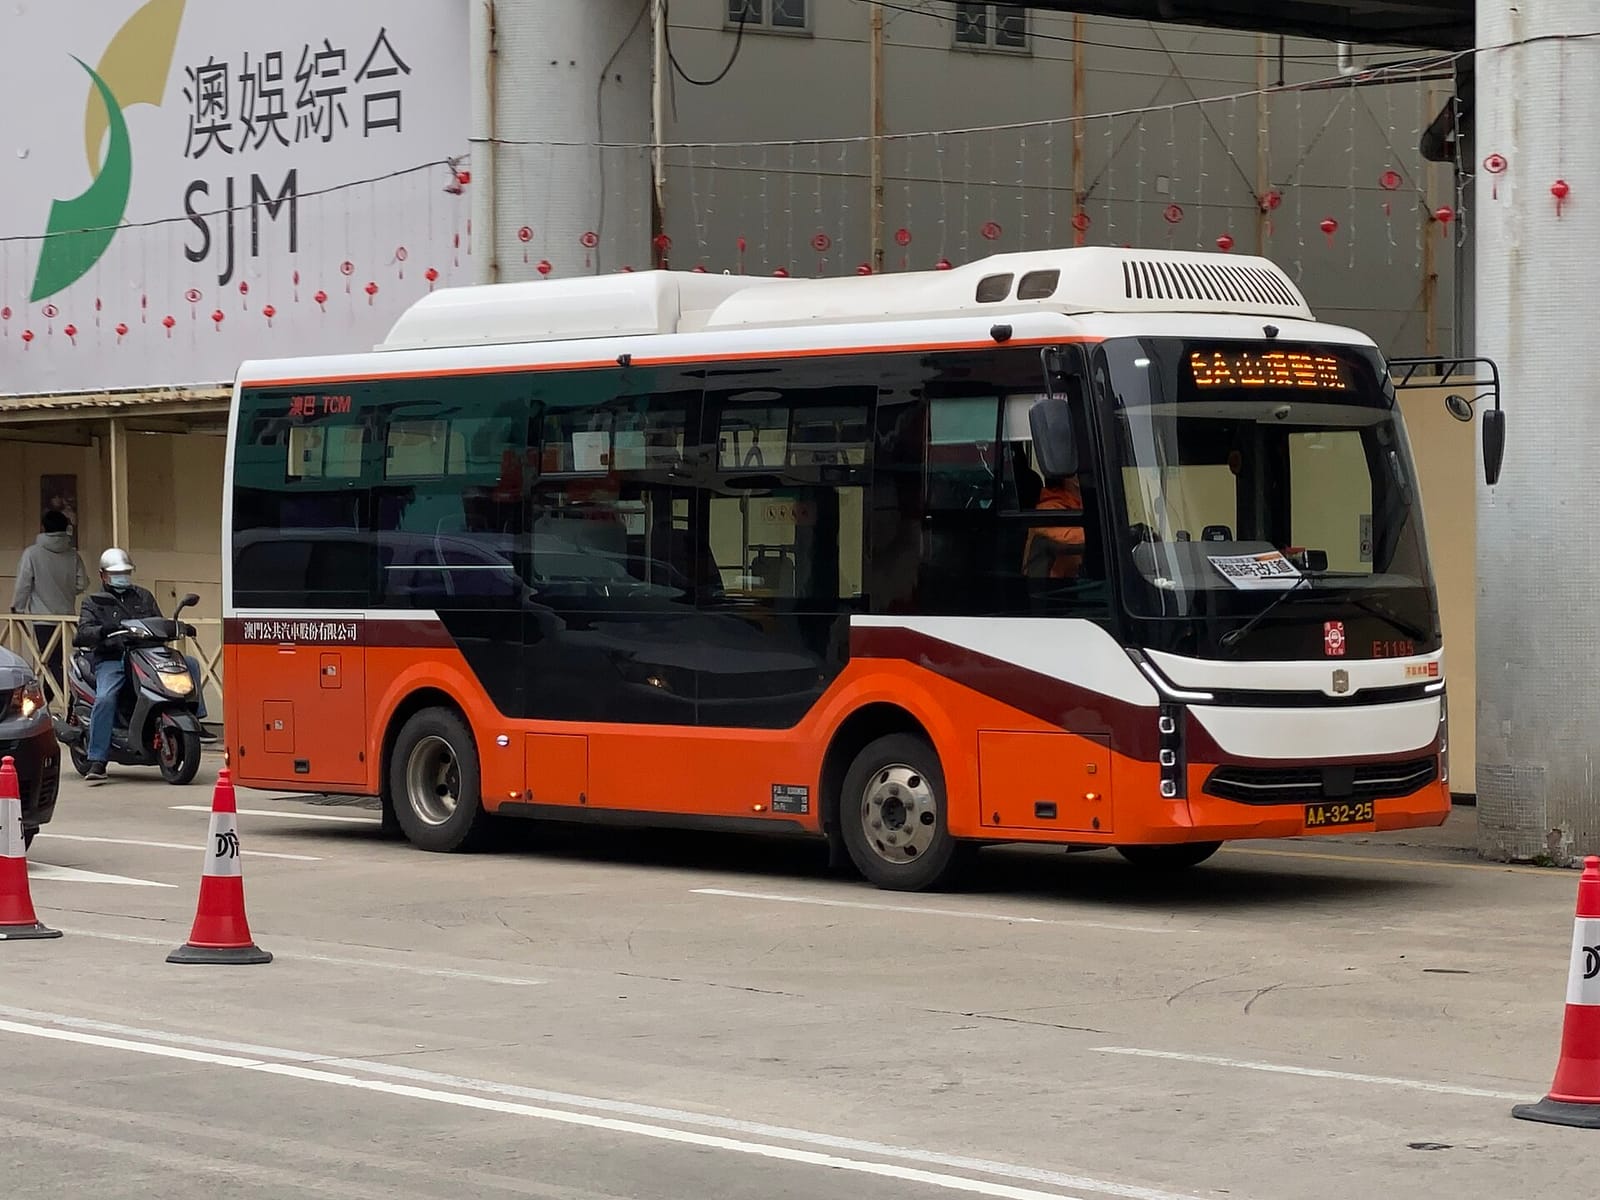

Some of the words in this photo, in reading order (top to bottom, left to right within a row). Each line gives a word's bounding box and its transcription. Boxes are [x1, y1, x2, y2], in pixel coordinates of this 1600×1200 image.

[182, 26, 412, 160] 澳娛綜合
[183, 168, 297, 287] SJM
[322, 395, 351, 414] TCM
[243, 621, 357, 641] 澳門公共汽車股份有限公司
[1371, 639, 1415, 658] E1195
[1306, 802, 1373, 825] AA-32-25
